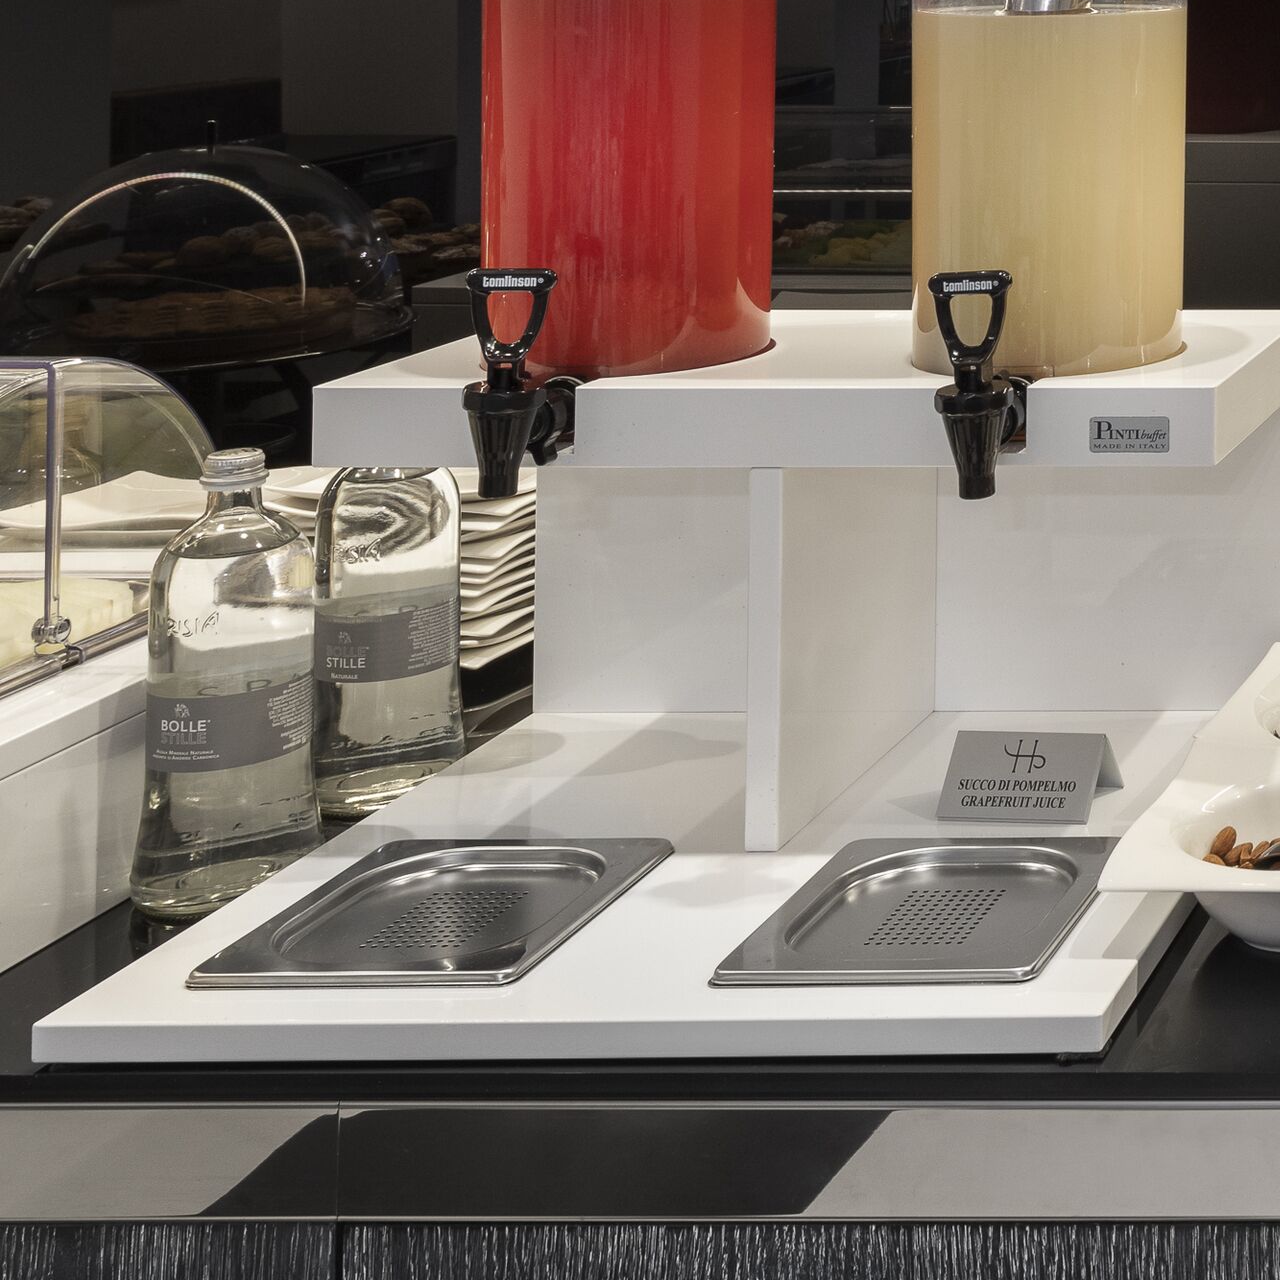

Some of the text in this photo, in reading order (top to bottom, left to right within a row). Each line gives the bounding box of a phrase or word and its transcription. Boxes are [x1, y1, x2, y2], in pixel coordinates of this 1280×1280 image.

[326, 657, 366, 669] STILLE
[161, 732, 207, 745] STILLE
[958, 778, 1077, 792] SUCCO DI POMPELMO
[961, 794, 1066, 809] GRAPEFRUIT JUICE
